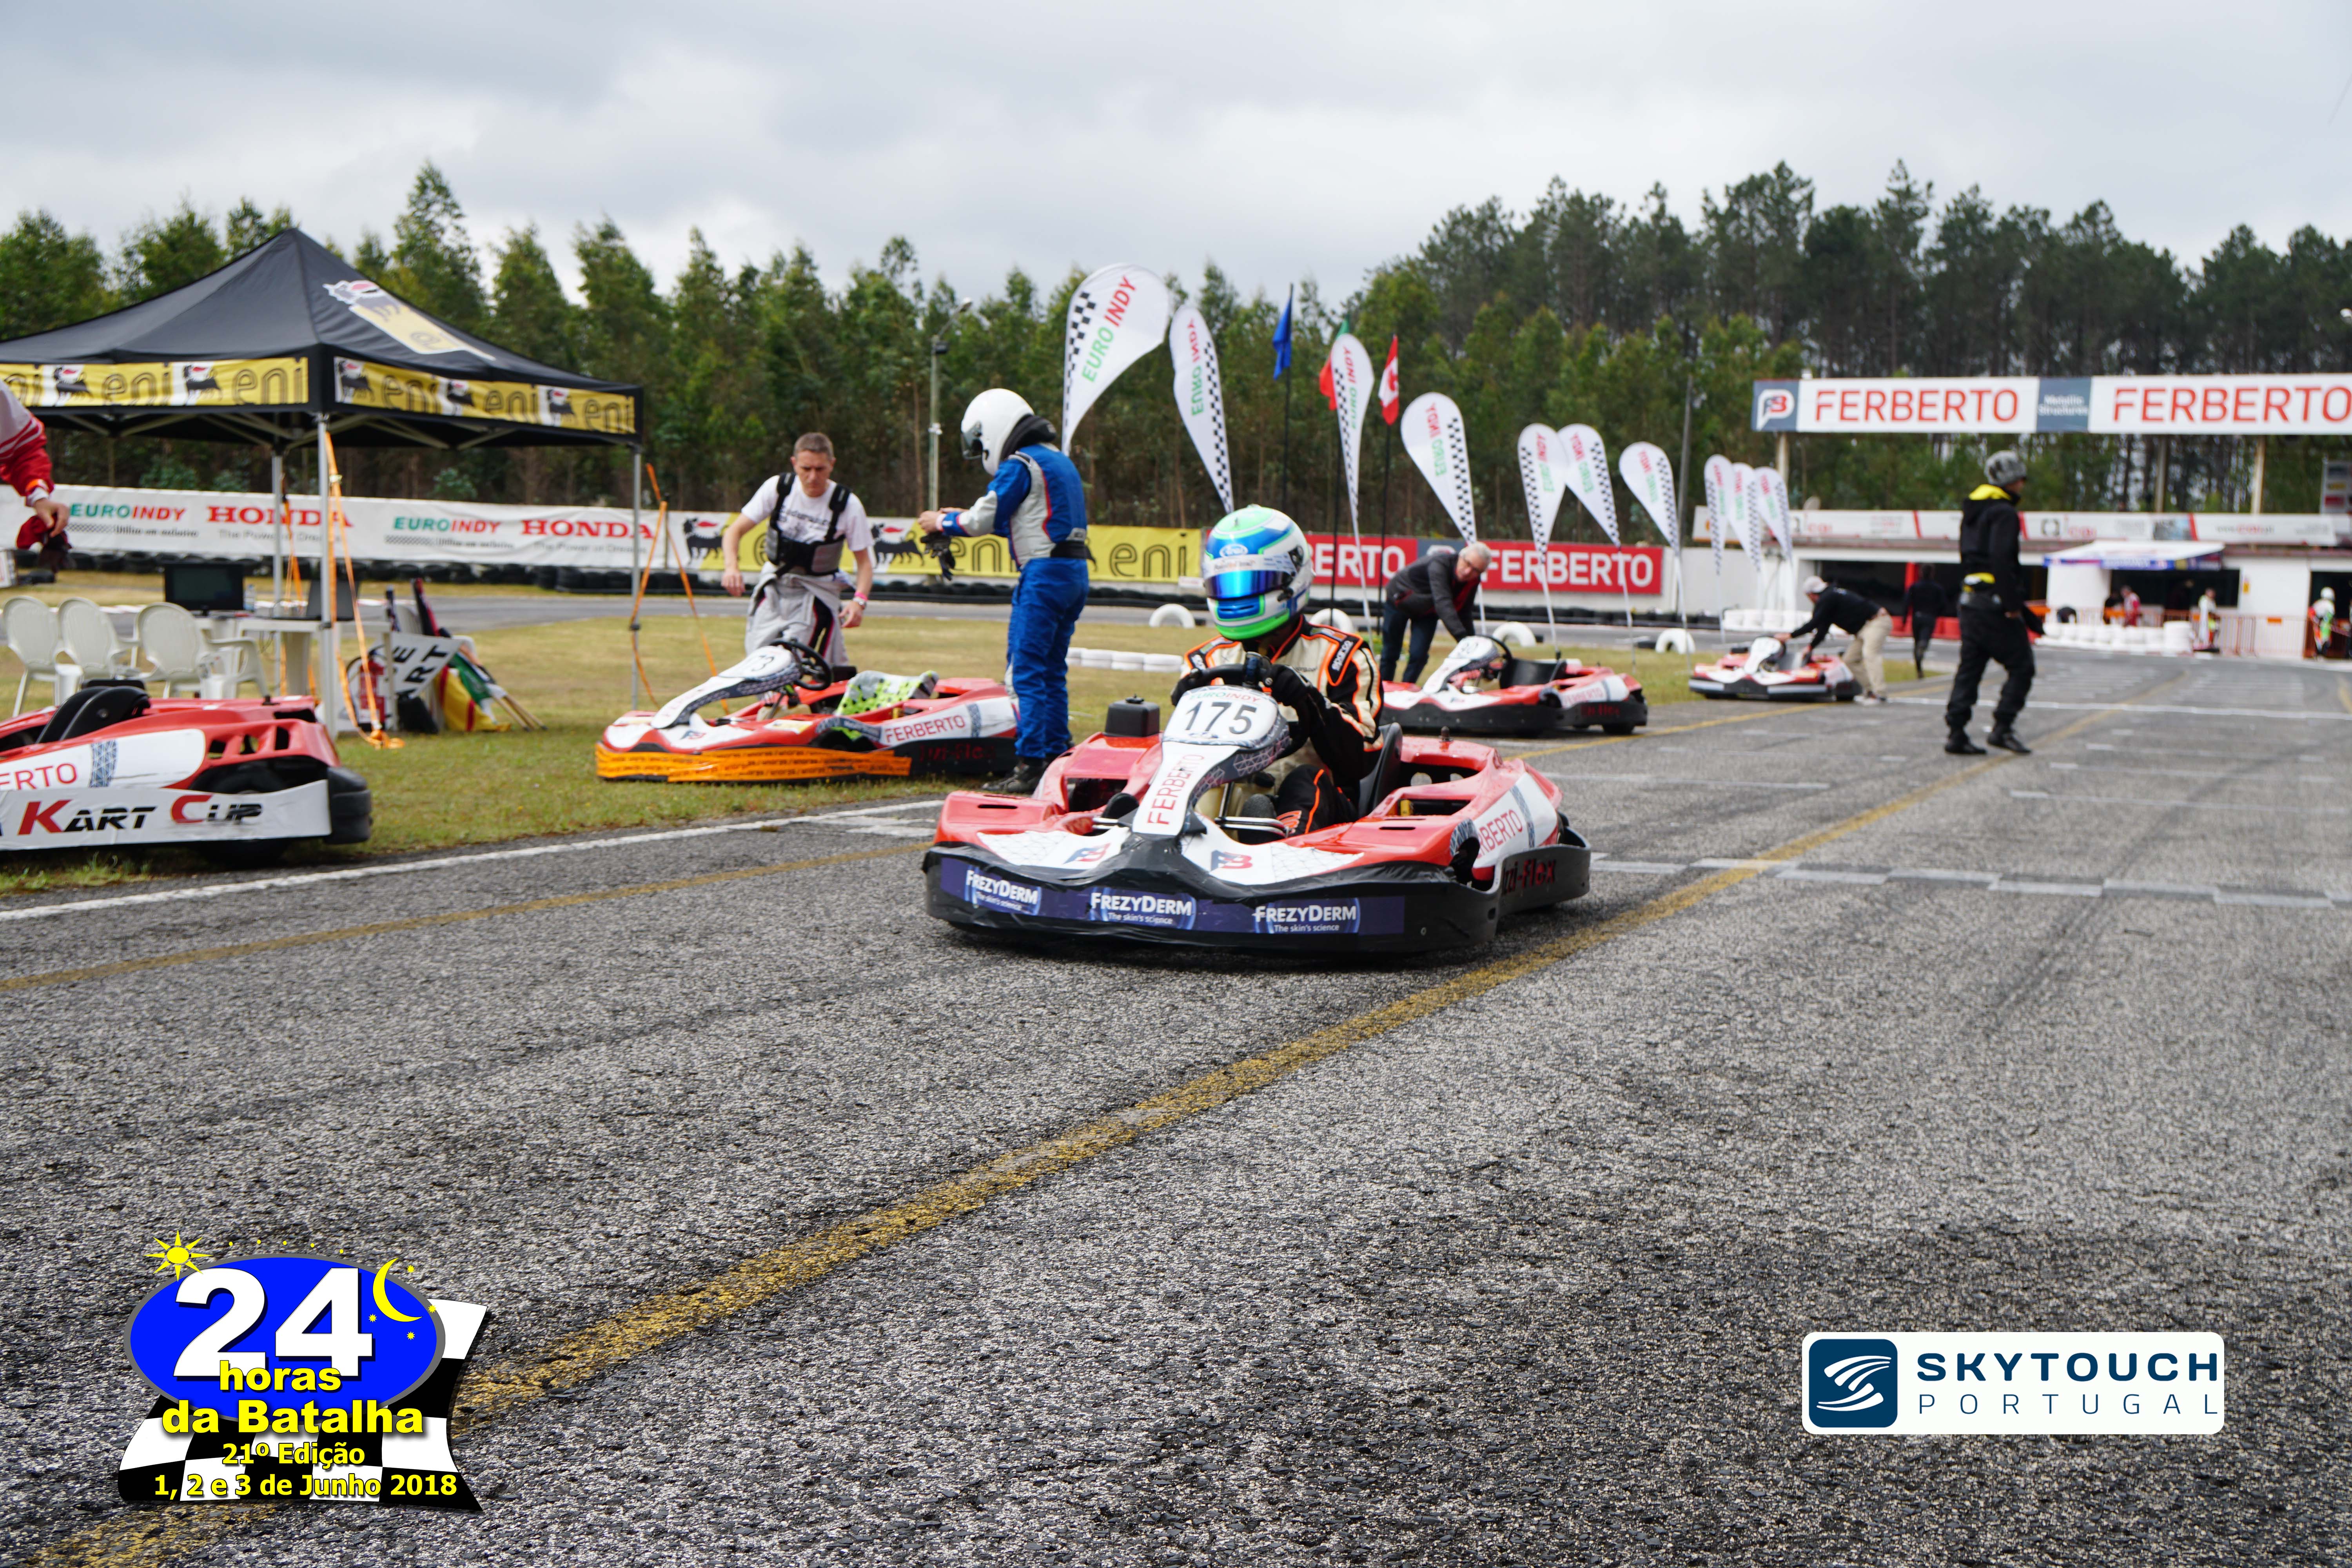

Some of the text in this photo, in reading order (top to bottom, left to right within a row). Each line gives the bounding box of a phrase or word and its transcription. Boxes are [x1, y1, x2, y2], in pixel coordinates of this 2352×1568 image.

[1081, 276, 1137, 383] EURO INDY
[101, 362, 173, 407] eni
[234, 357, 304, 404] eni
[485, 384, 539, 424] eni
[1815, 389, 2019, 422] FERBERTO
[2113, 386, 2352, 423] FERBERTO
[70, 503, 186, 521] EUROINDY
[394, 516, 501, 534] EUROINDY
[521, 520, 656, 539] HONDA
[1109, 533, 1187, 577] eni
[884, 715, 965, 743] FERBERTO
[1185, 701, 1257, 735] 175
[18, 794, 264, 835] KART CUP
[966, 869, 1039, 905] FREZYDERM
[1091, 892, 1192, 916] FREZYDERM
[1108, 912, 1122, 920] The
[1255, 905, 1357, 922] FREZYDERM
